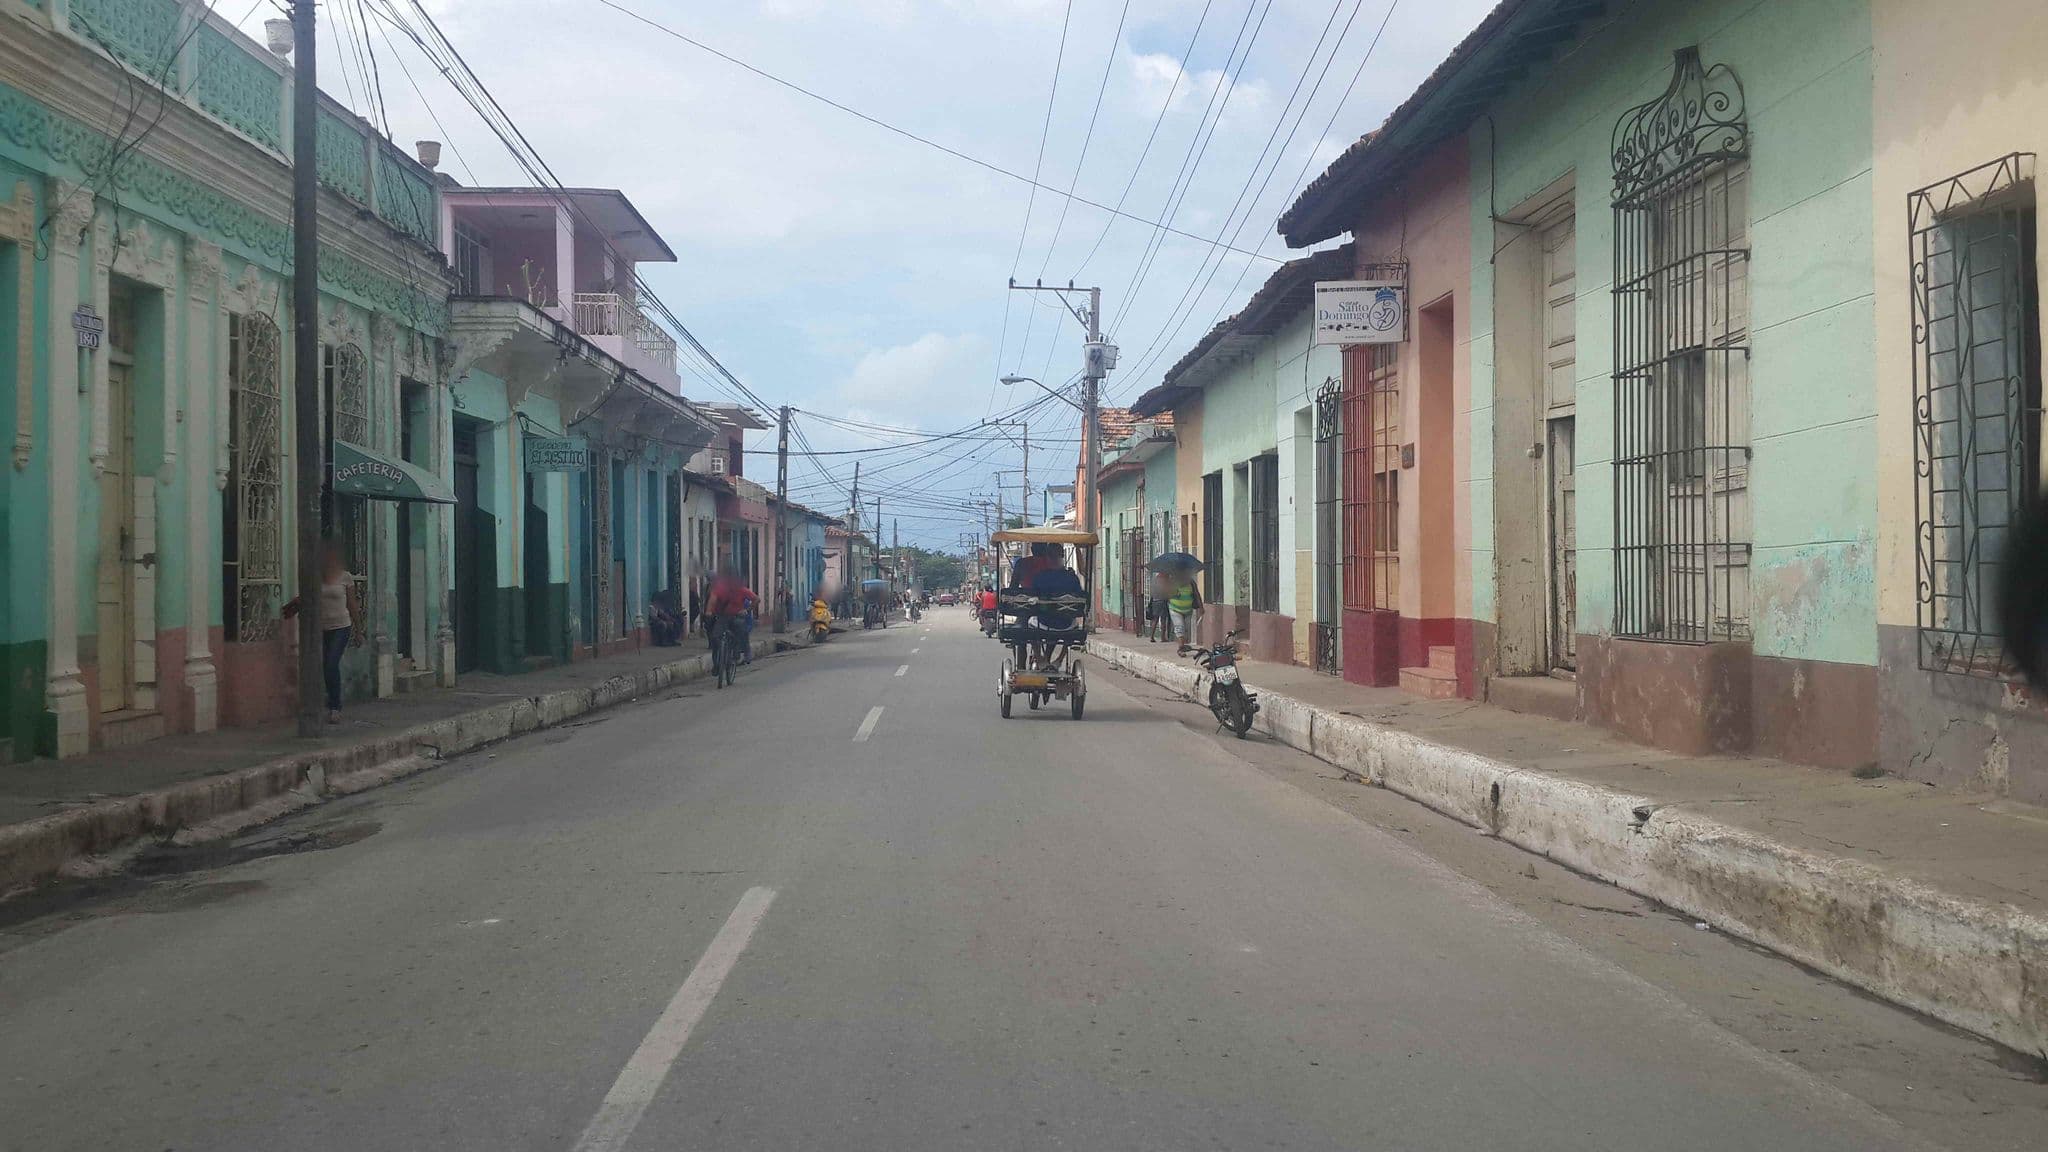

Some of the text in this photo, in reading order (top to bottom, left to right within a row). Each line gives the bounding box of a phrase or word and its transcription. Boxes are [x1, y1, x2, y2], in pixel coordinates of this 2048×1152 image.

[1339, 301, 1369, 312] Santo
[1319, 309, 1369, 321] Domingo
[336, 462, 403, 484] CAFETERIA
